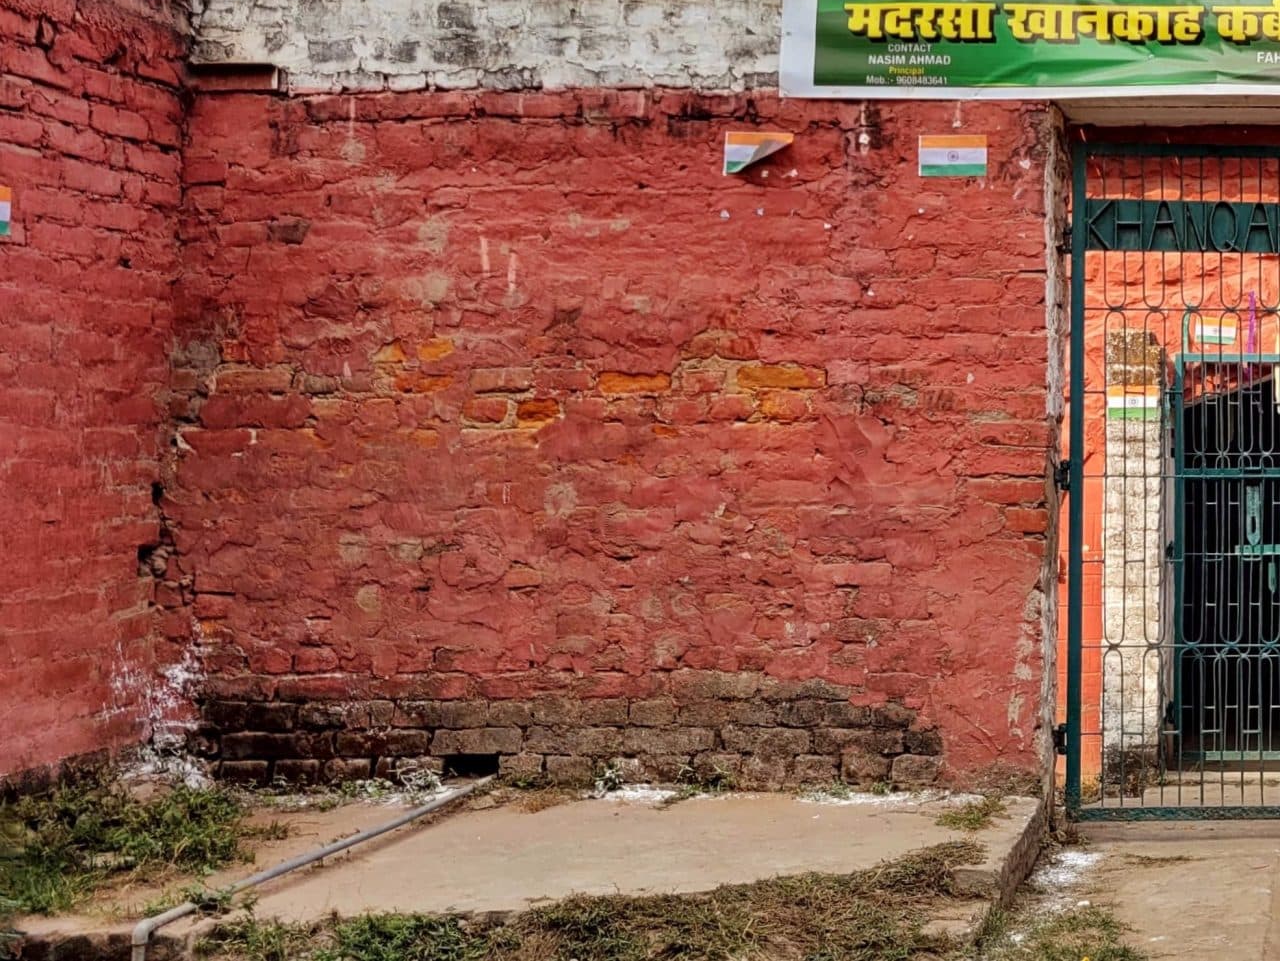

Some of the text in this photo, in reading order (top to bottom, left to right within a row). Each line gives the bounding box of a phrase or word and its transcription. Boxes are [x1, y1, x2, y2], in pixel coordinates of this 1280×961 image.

[844, 2, 996, 40] मदरसा
[1003, 3, 1205, 41] खानकाह
[888, 44, 932, 53] CONTACT
[868, 55, 951, 65] NASIM AHMAD
[888, 66, 925, 76] Principal
